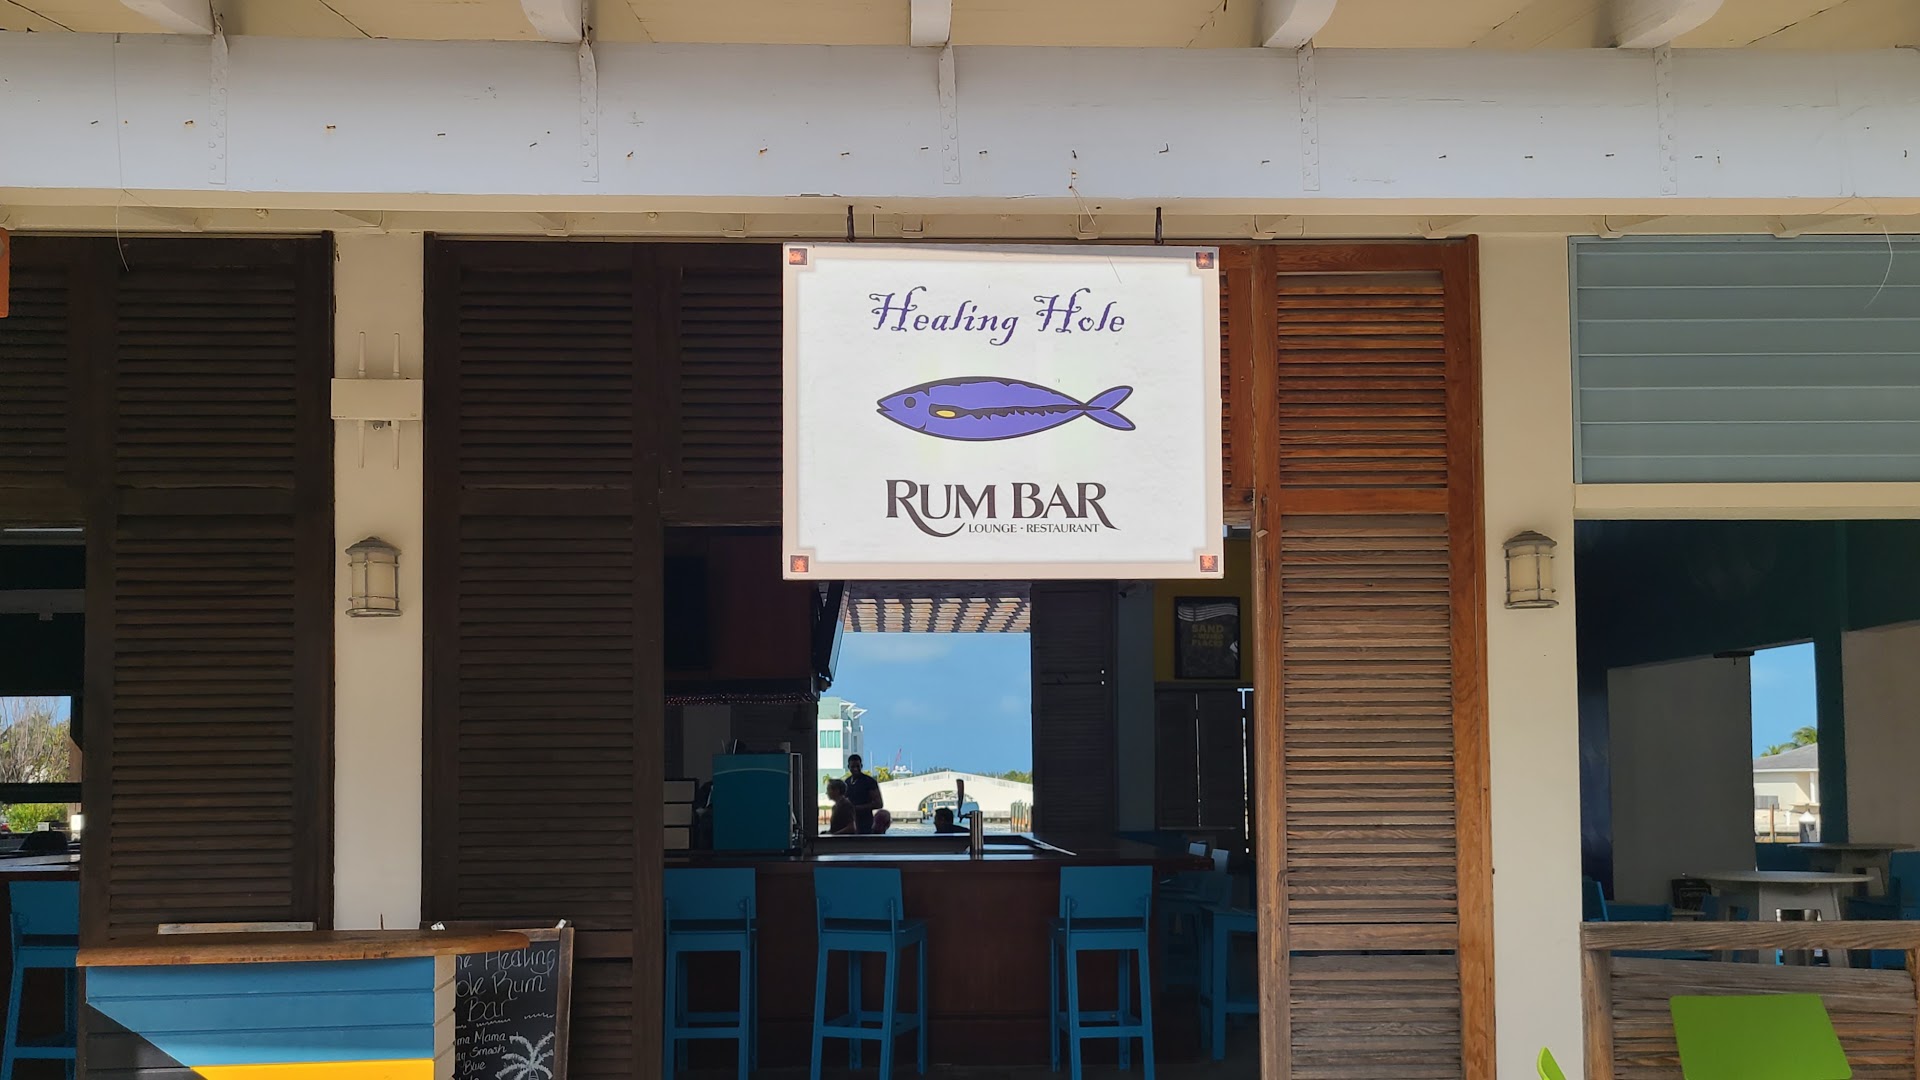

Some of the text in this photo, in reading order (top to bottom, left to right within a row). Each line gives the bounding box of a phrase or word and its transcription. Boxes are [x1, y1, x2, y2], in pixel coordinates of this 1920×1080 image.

[869, 286, 1124, 345] Healing Hole
[886, 480, 1121, 537] RUM BAR
[968, 523, 1100, 533] LOUNGE RESTAURANT
[1192, 624, 1224, 633] SAND
[485, 948, 556, 977] Healing
[456, 970, 547, 1000] ole Rum
[464, 996, 509, 1022] Bar
[474, 1028, 507, 1045] Mama
[463, 1060, 487, 1076] Blue
